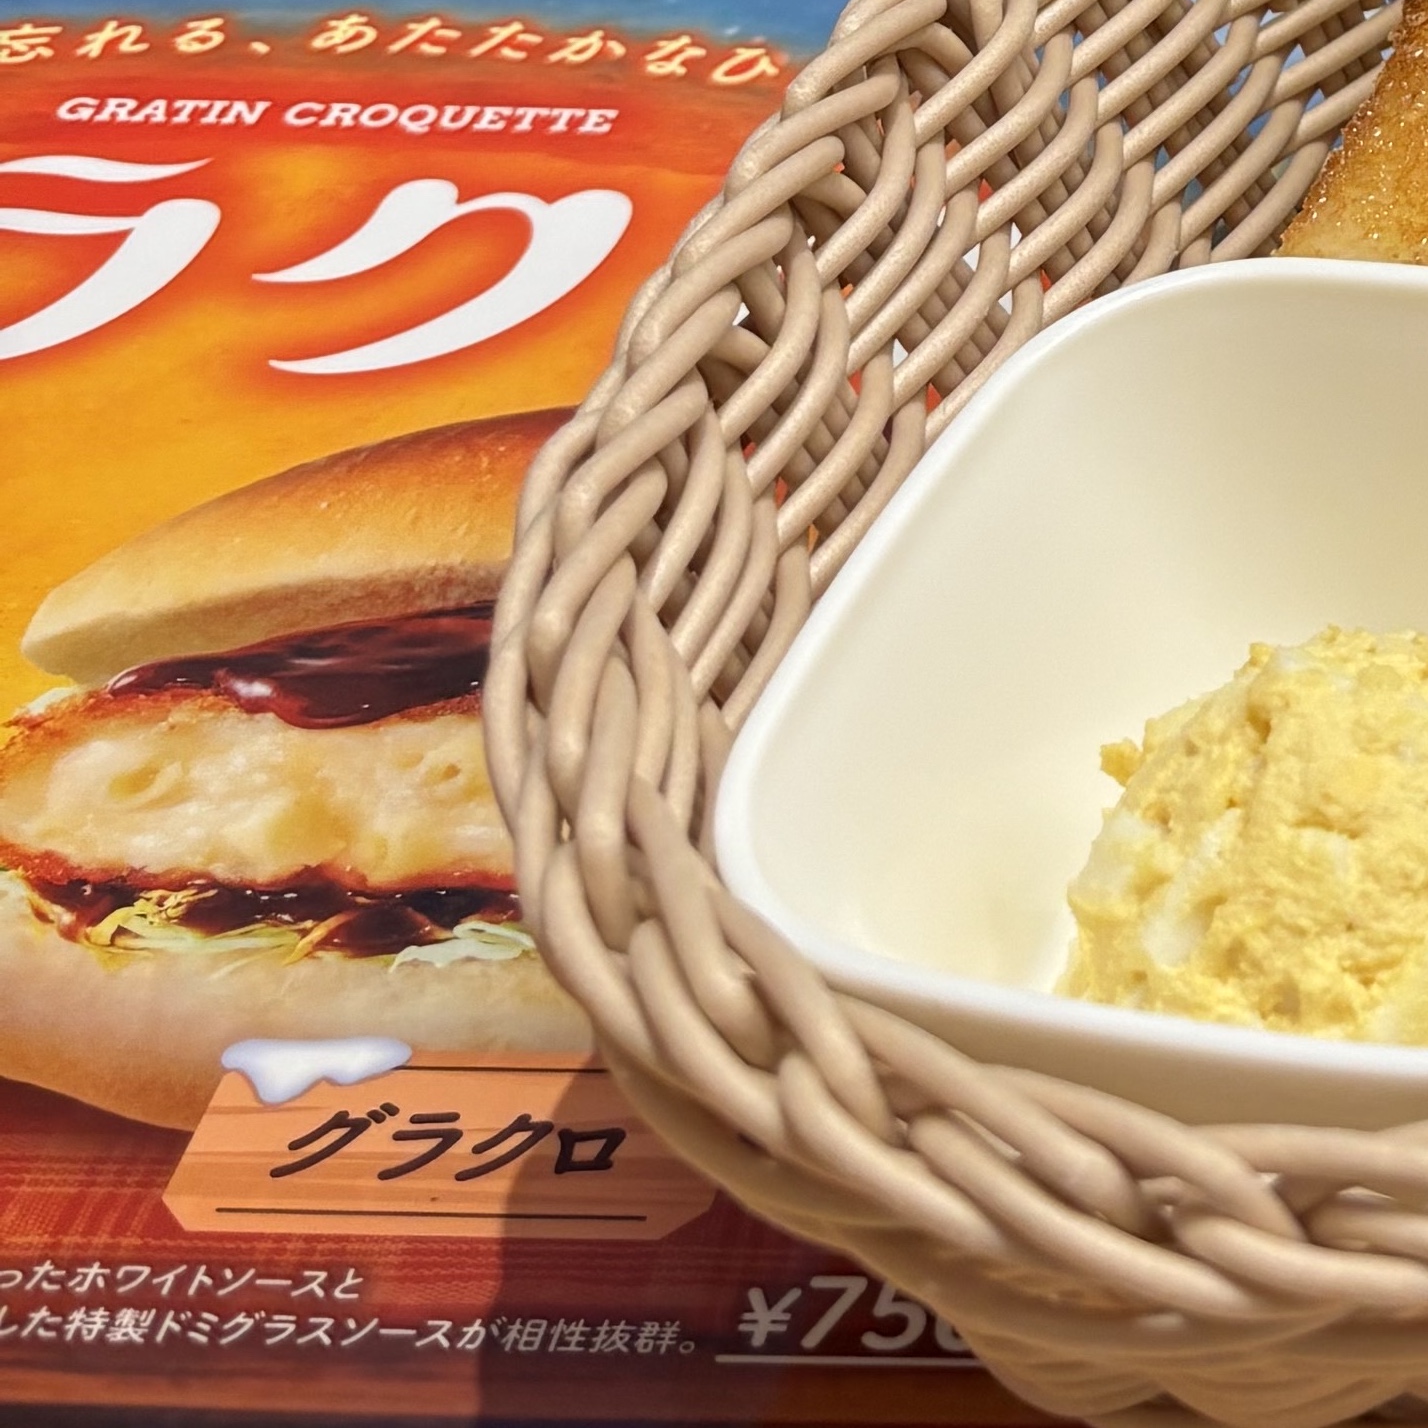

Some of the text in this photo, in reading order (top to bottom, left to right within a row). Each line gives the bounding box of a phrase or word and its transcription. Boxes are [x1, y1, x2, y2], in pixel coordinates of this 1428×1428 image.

[55, 95, 620, 137] GRATIN CROQUETTE
[269, 1101, 628, 1182] グラクロ
